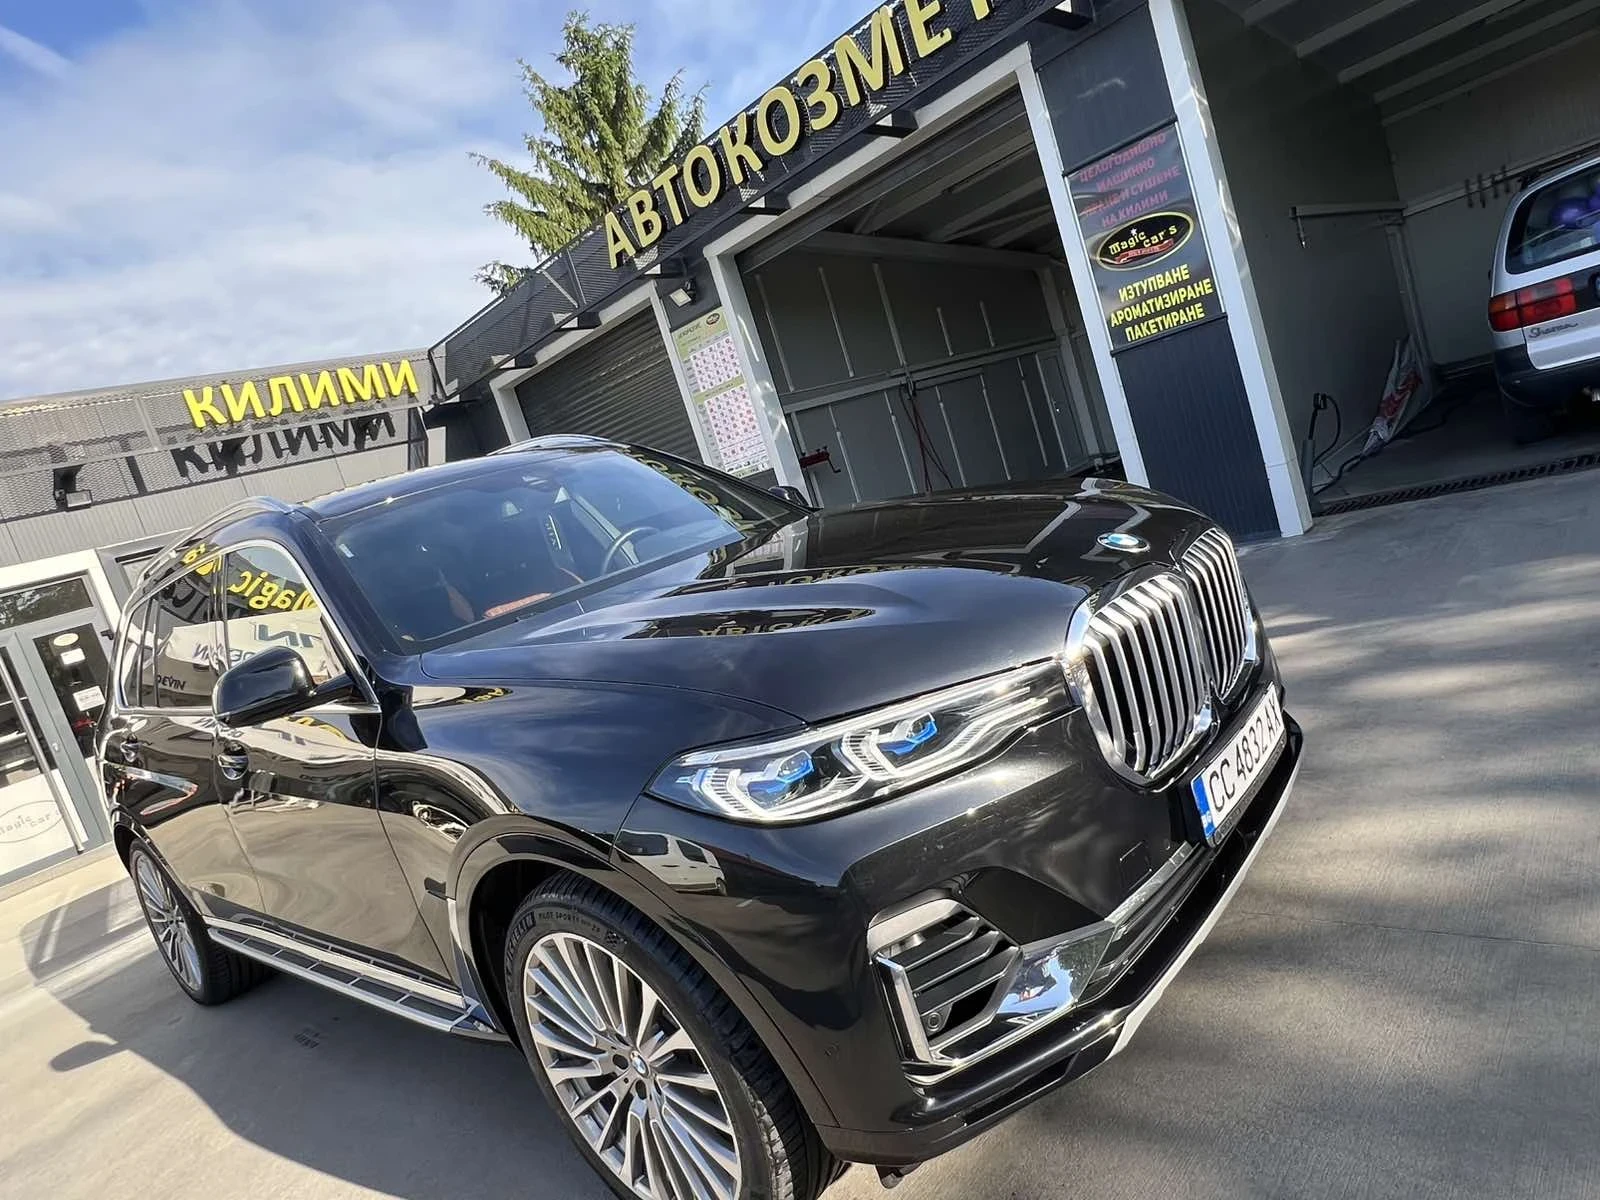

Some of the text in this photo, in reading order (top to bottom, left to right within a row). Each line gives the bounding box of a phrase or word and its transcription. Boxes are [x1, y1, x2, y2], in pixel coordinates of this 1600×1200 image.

[603, 0, 990, 270] АВТОКОЗМЕ
[1108, 231, 1147, 255] Magic
[1109, 278, 1214, 328] АРОМАТИЗИРАНЕ
[1118, 263, 1190, 302] ИЗТУПВАНЕ
[1125, 302, 1206, 342] ПАКЕТИРАНЕ
[183, 359, 419, 429] КИЛИМИ
[1209, 758, 1236, 812] CC
[1235, 716, 1268, 781] 4832
